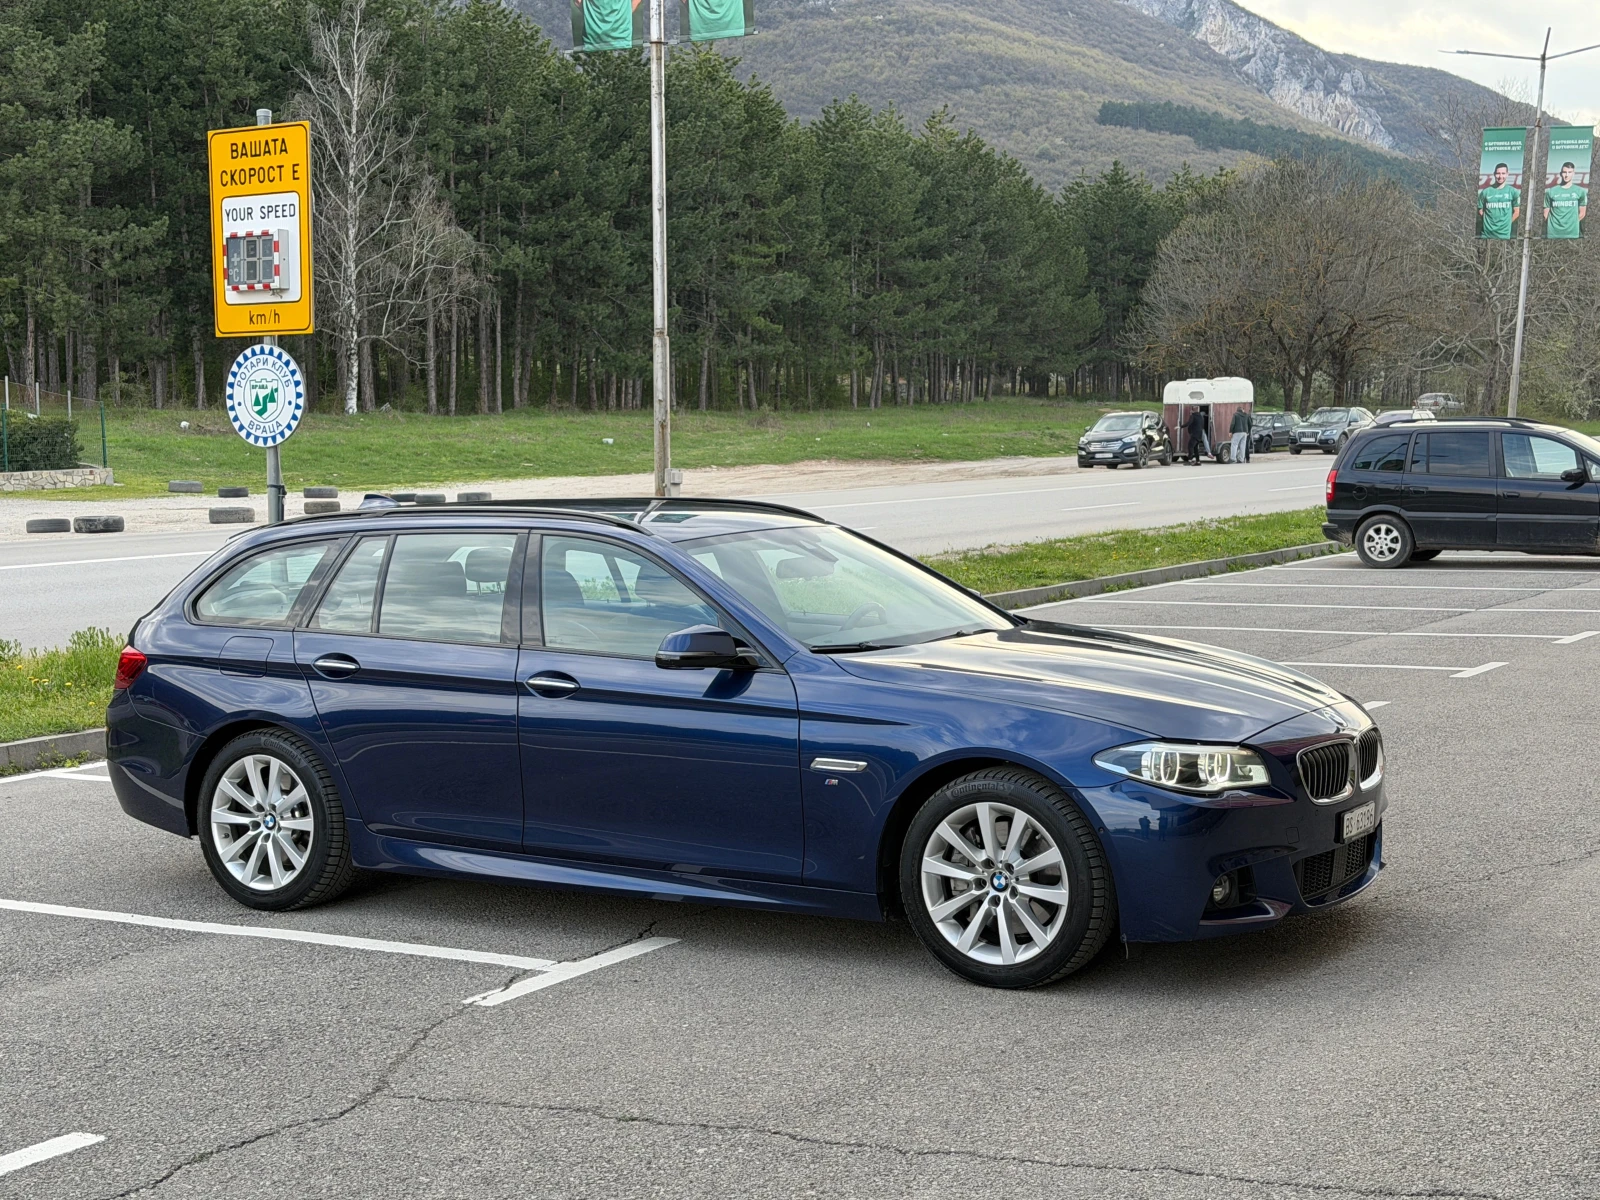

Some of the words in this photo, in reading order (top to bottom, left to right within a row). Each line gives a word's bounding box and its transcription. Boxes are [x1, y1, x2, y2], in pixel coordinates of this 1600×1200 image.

[230, 137, 288, 159] ВАШАТА
[220, 164, 284, 187] СКОРОСТ
[292, 163, 300, 180] Е
[225, 206, 253, 222] YOUR
[260, 203, 296, 219] SPEED
[249, 309, 280, 325] km/h
[236, 357, 269, 389] РОТАРИ
[271, 359, 292, 388] КЛУБ
[247, 420, 283, 435] ВРАЦА
